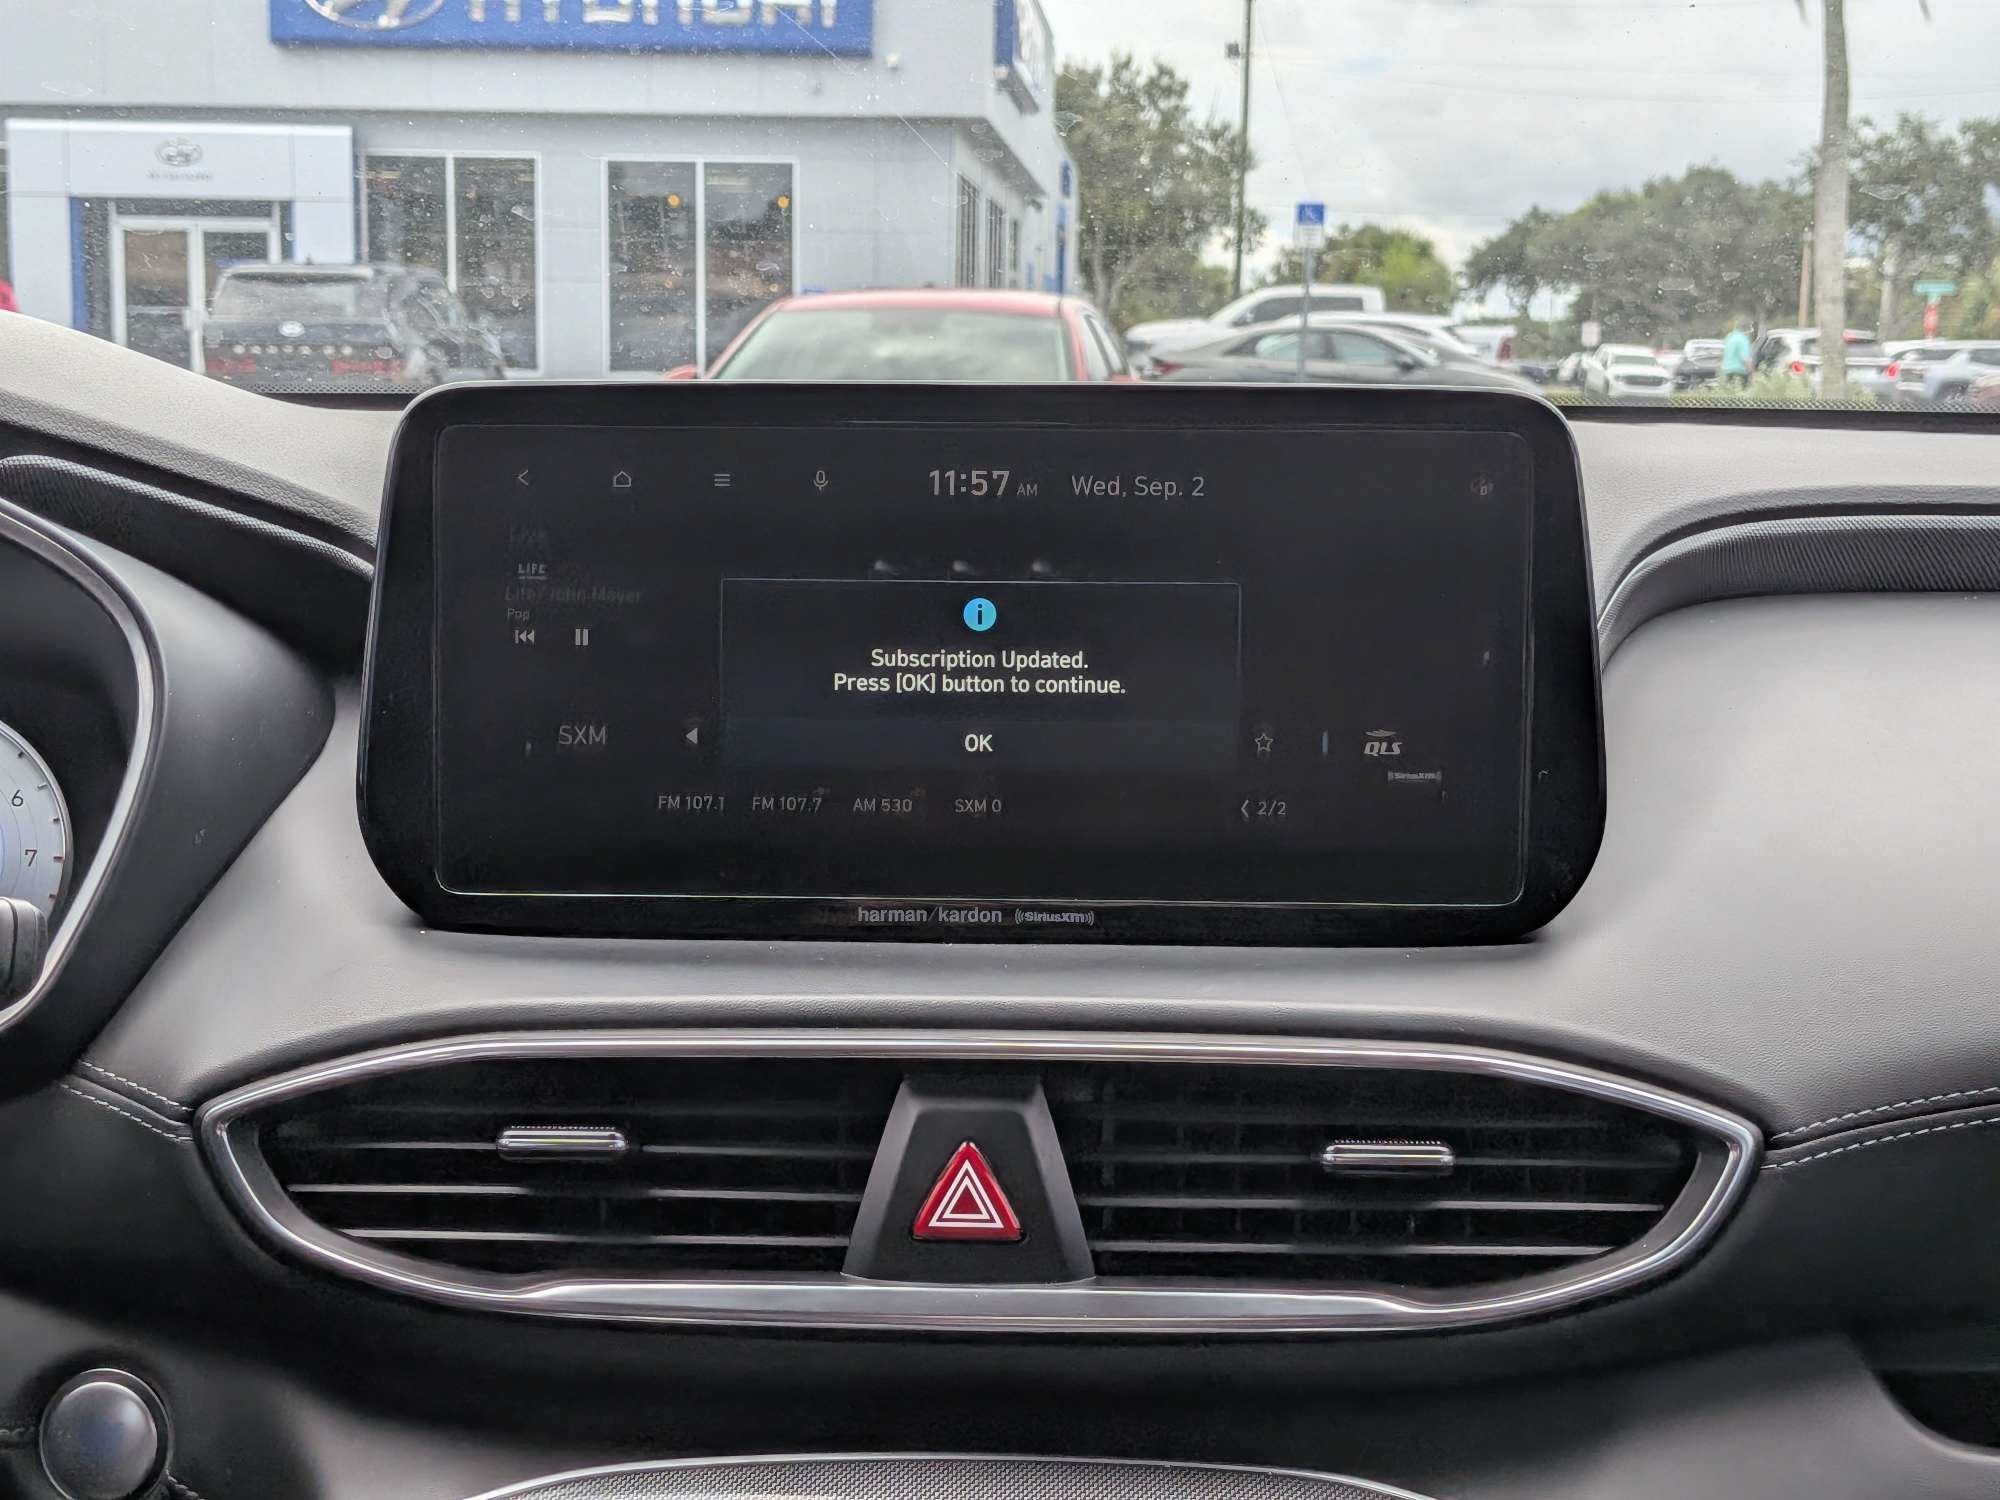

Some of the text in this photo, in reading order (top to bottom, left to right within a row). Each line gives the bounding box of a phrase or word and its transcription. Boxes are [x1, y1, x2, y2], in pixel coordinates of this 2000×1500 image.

[929, 470, 1038, 497] 11:57 AM
[1134, 476, 1183, 500] Sep.
[1191, 477, 1205, 496] 2
[507, 607, 531, 622] Pop
[871, 649, 1089, 672] Subscription Updated.
[834, 673, 1126, 694] Press [OK] button to continue.
[558, 725, 607, 745] SXM
[964, 734, 993, 752] OK
[11, 789, 24, 807] 6
[657, 795, 726, 811] FM 107.1
[752, 796, 822, 812] FM 107.7
[853, 797, 913, 812] AM 530
[954, 799, 1002, 813] SXM 0
[1256, 800, 1287, 817] 2/2
[24, 849, 38, 867] 7
